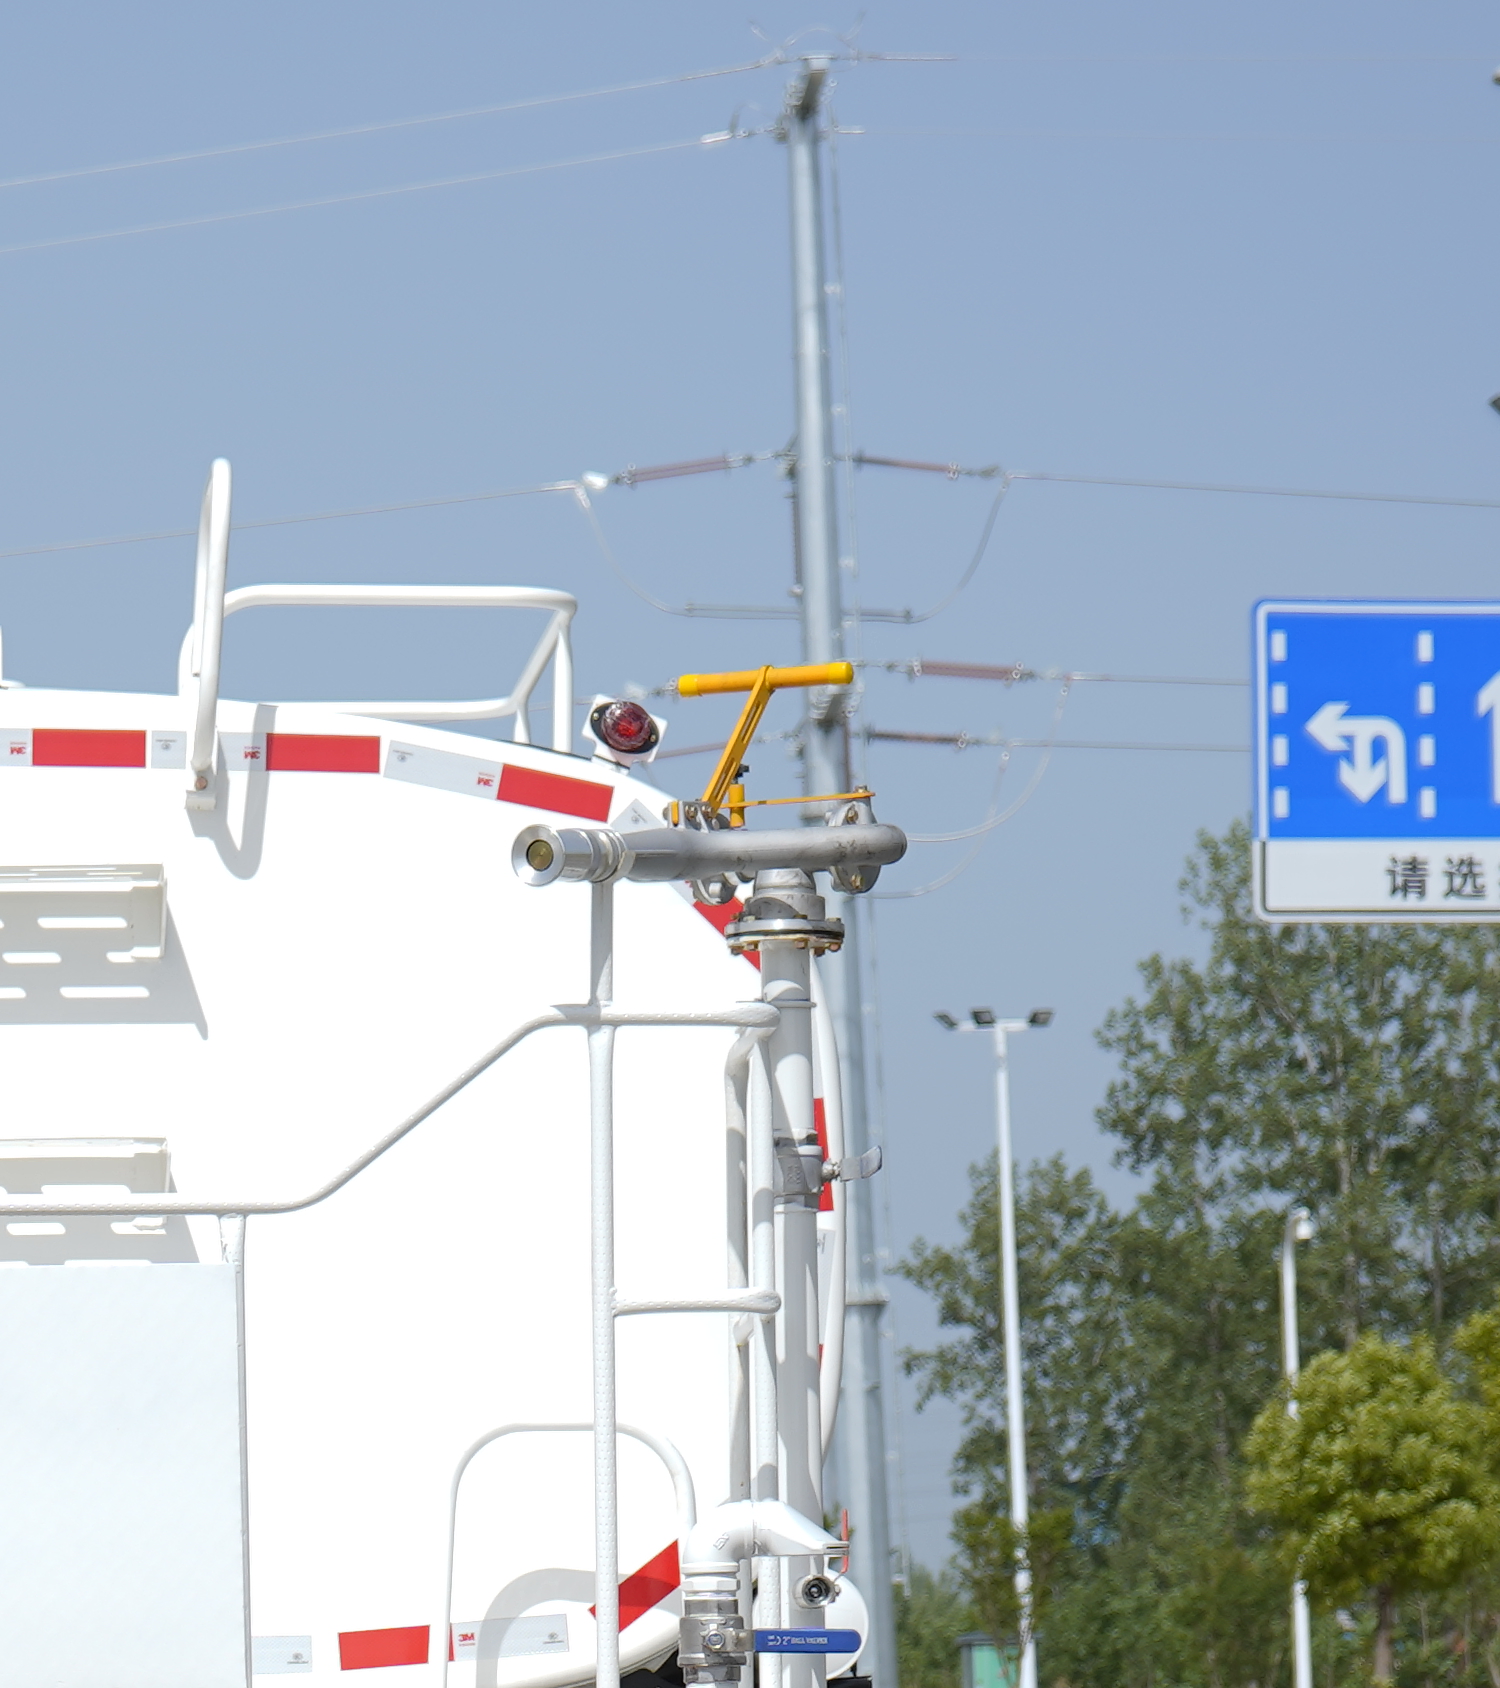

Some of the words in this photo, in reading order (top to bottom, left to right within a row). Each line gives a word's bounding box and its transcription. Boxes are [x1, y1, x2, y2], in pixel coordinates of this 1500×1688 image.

[10, 746, 27, 755] 3M
[243, 750, 261, 760] 3M
[477, 776, 494, 787] 3M
[458, 1632, 475, 1642] 3M
